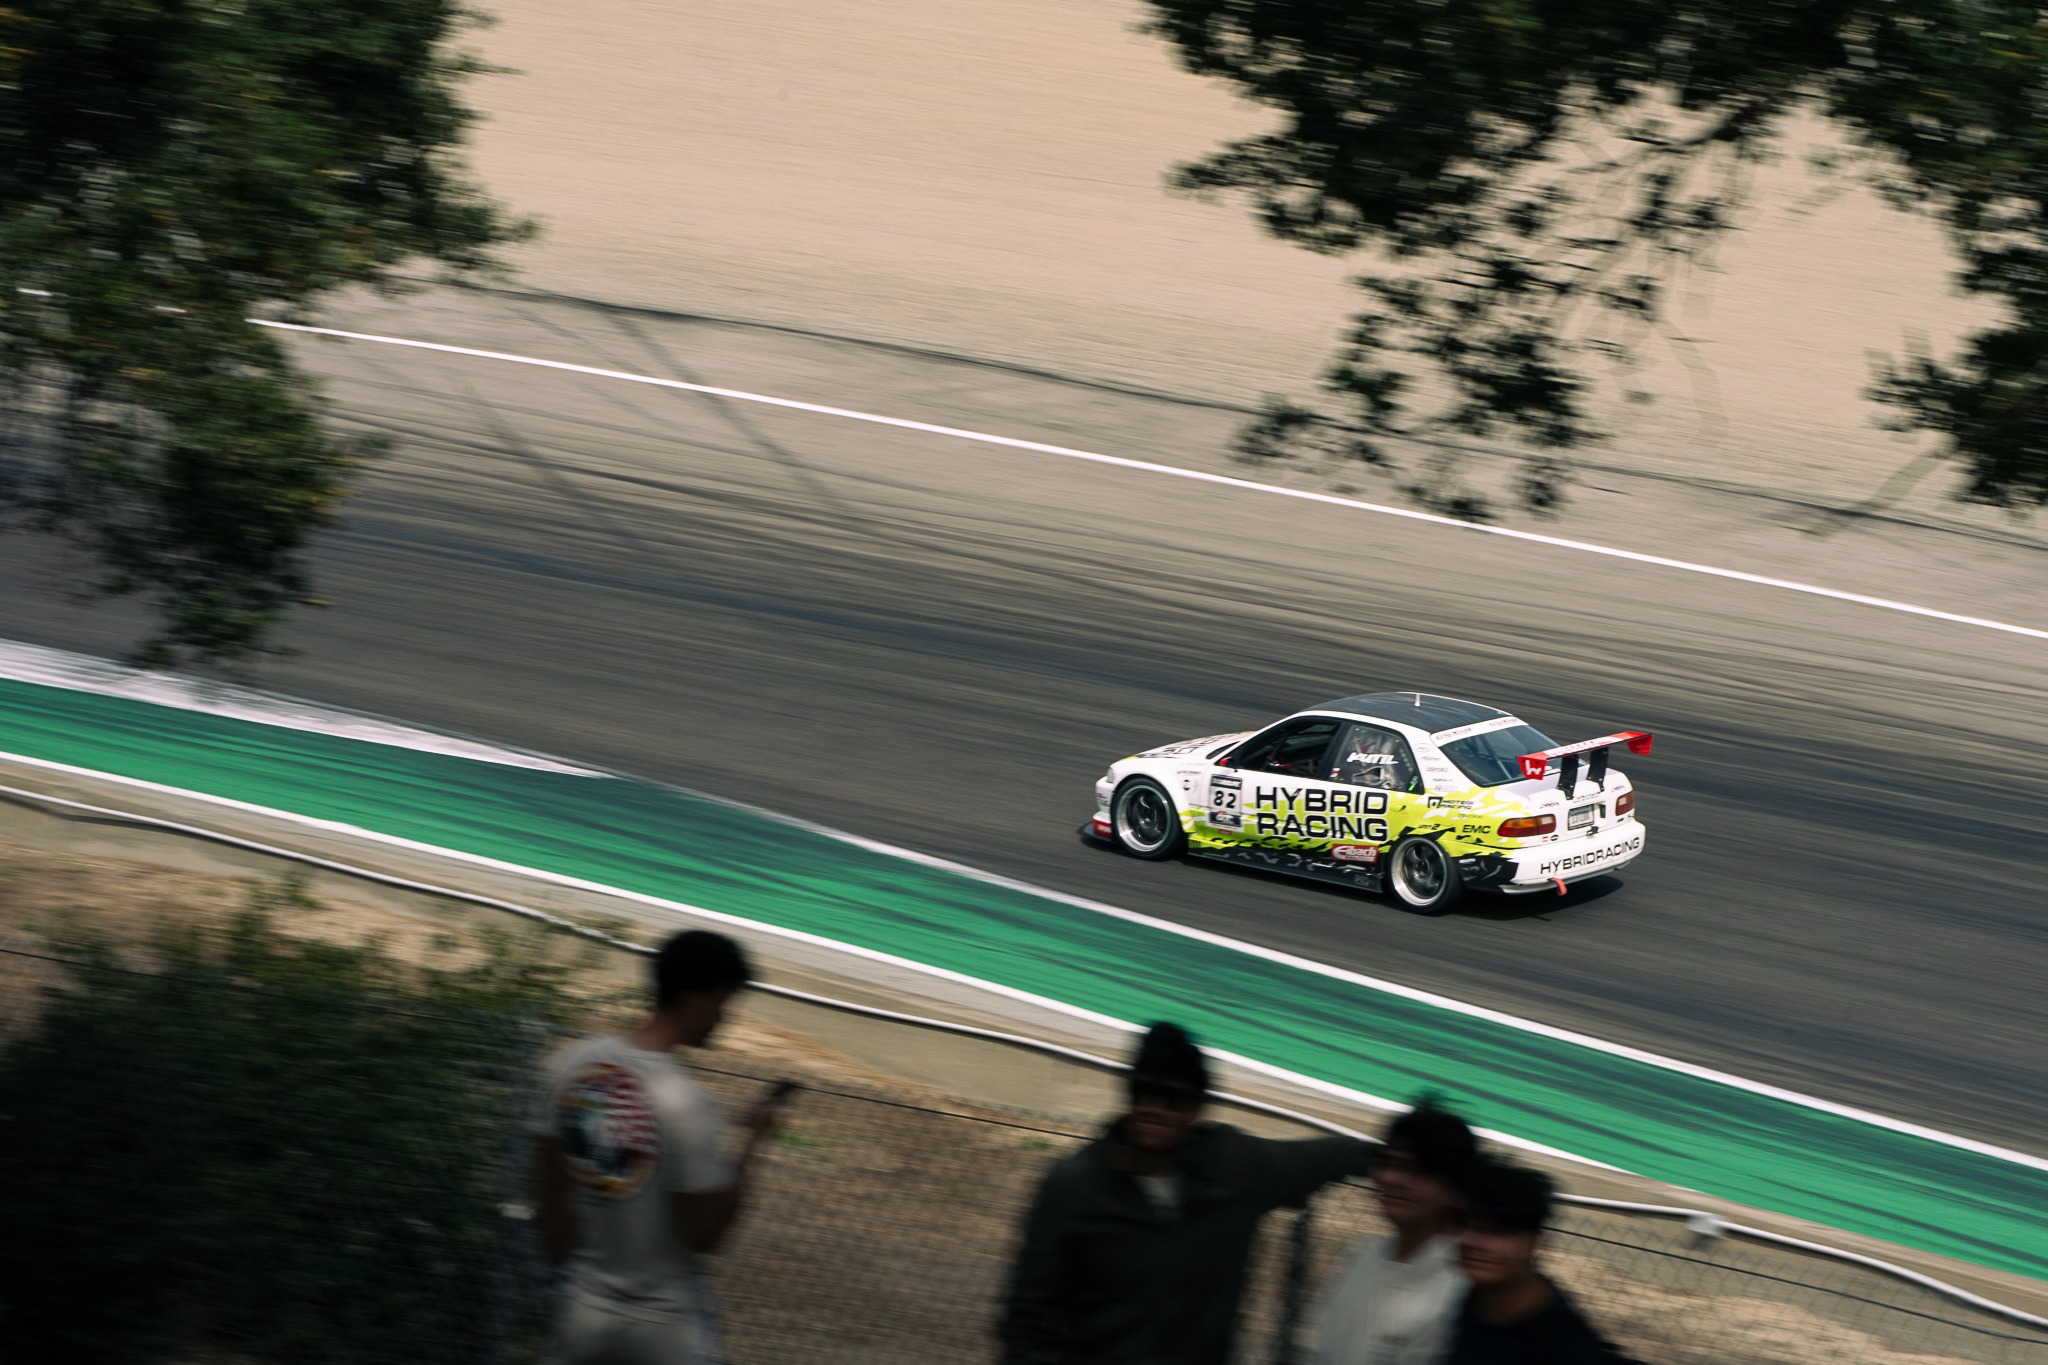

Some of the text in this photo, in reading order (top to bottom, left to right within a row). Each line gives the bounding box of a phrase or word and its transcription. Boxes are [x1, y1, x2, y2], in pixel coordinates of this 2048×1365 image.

[1213, 790, 1236, 809] 82
[1256, 786, 1389, 815] HYBRID
[1257, 812, 1389, 842] RACING
[1462, 824, 1491, 834] EMC
[1332, 845, 1377, 860] Eibach
[1540, 837, 1641, 875] HYBRIDRACING
